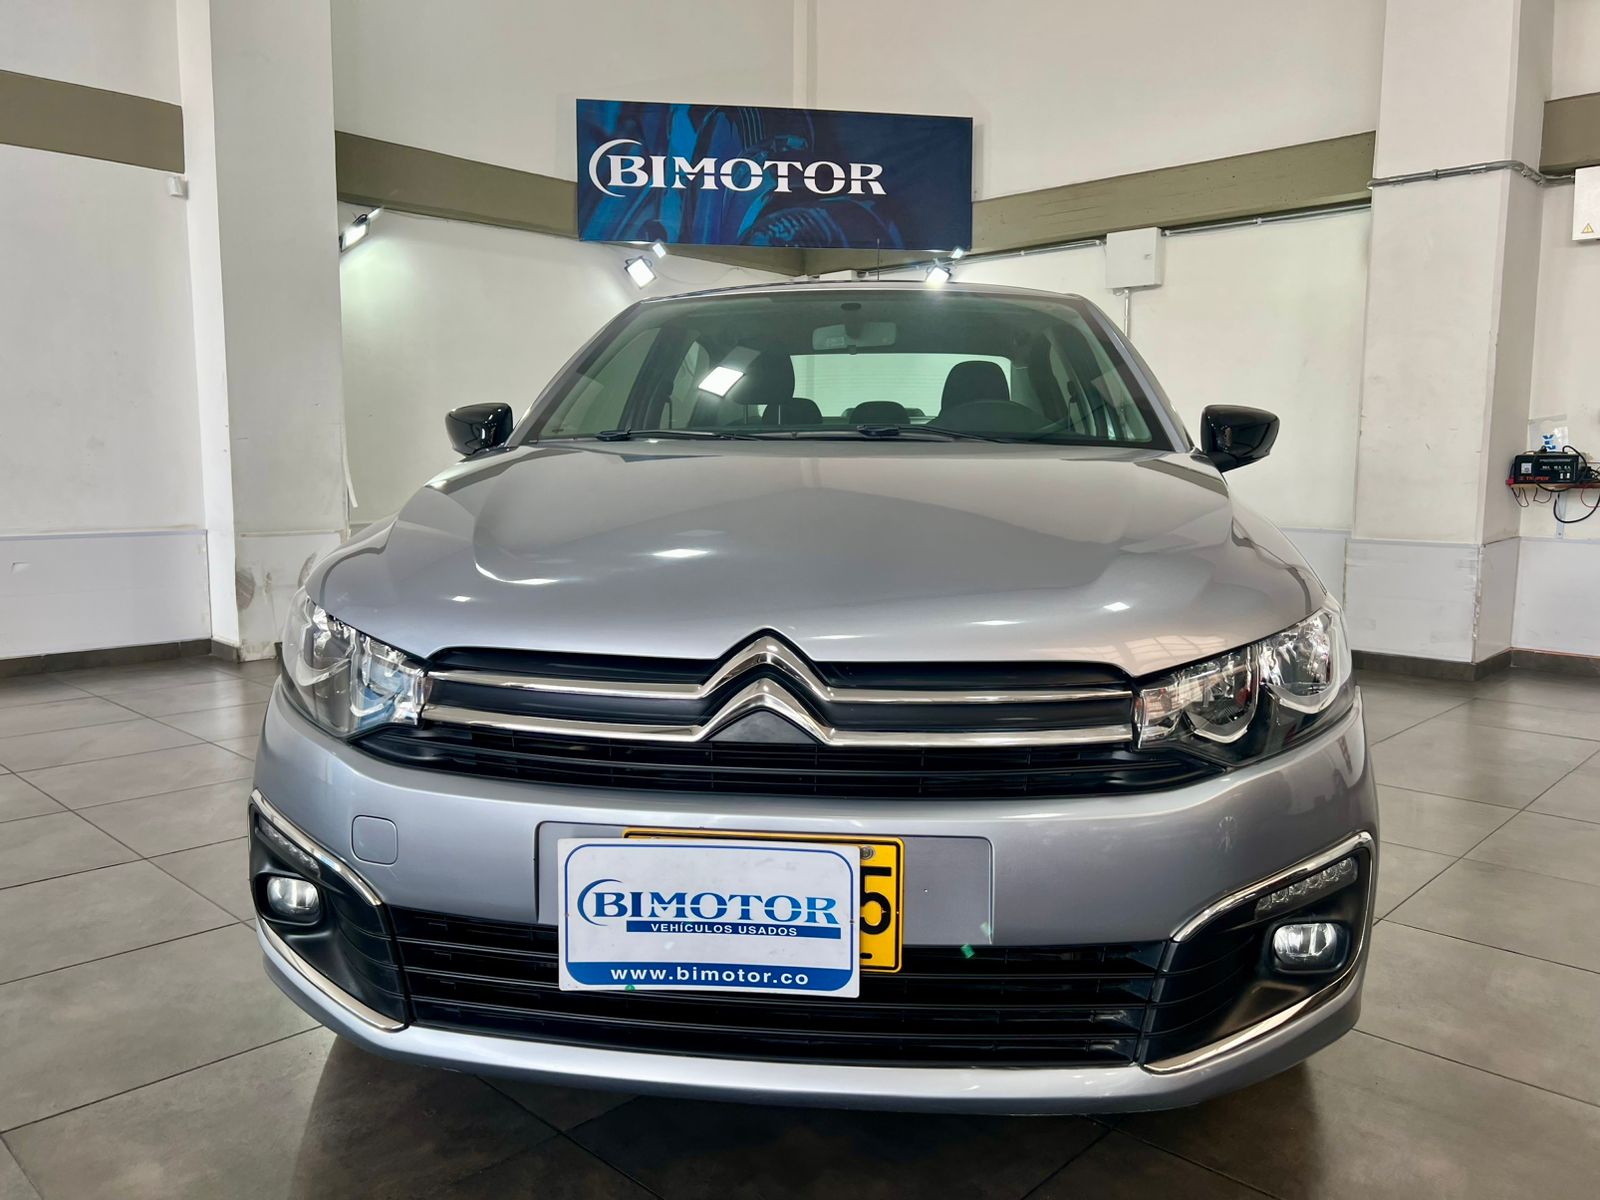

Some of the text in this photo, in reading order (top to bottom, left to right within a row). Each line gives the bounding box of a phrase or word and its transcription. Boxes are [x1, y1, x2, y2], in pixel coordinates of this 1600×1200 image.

[605, 154, 887, 195] BIMOTOR
[592, 890, 839, 925] BIMOTOR
[650, 921, 798, 936] VEHÍCULOS USADOS
[611, 966, 809, 985] www.bimotor.co
